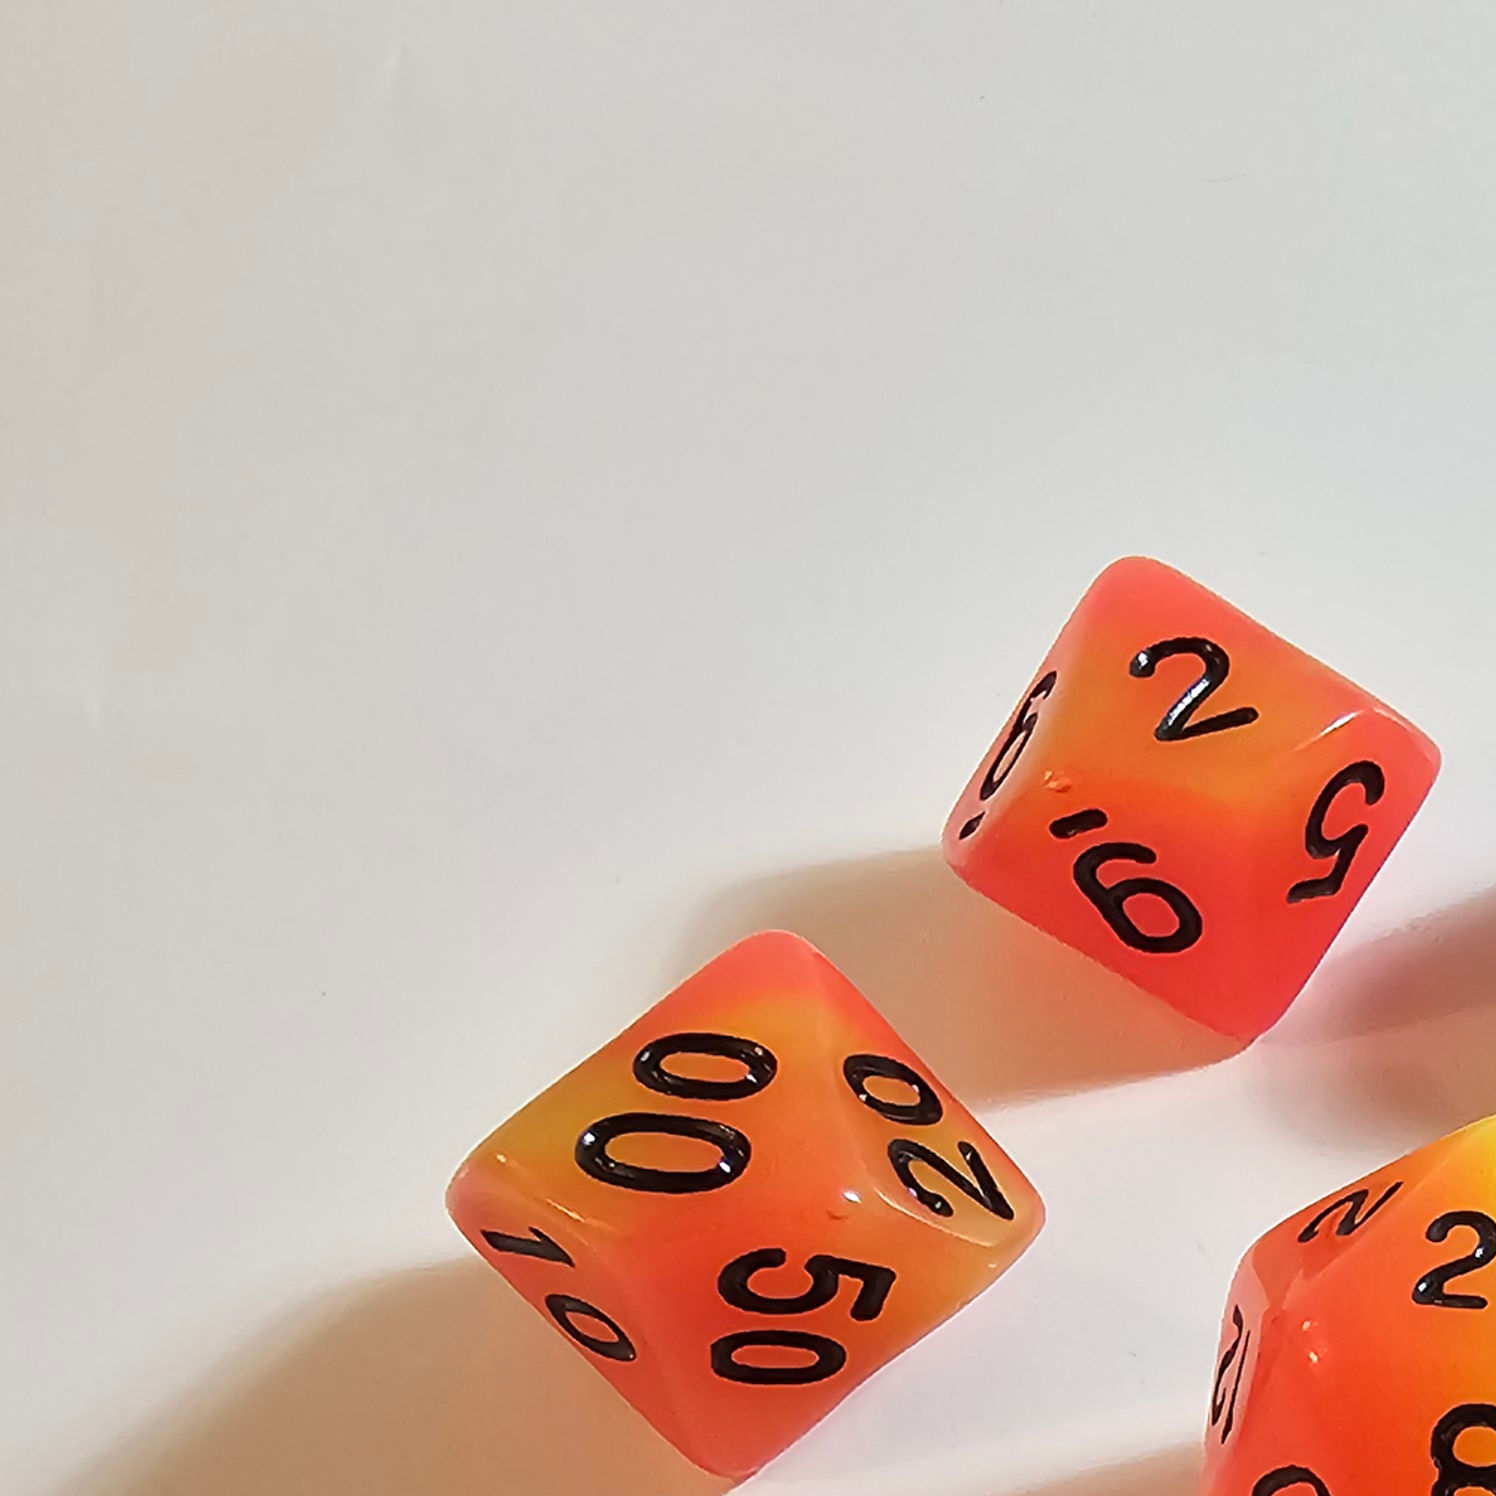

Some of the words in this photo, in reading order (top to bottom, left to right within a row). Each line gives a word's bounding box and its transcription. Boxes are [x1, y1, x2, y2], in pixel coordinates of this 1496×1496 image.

[1128, 636, 1260, 743] 2
[1287, 759, 1386, 904] 5
[574, 1031, 778, 1195] 00
[842, 1053, 1015, 1221] 20
[1297, 1181, 1404, 1243] 2
[480, 1226, 637, 1364] 10
[709, 1247, 898, 1387] 50
